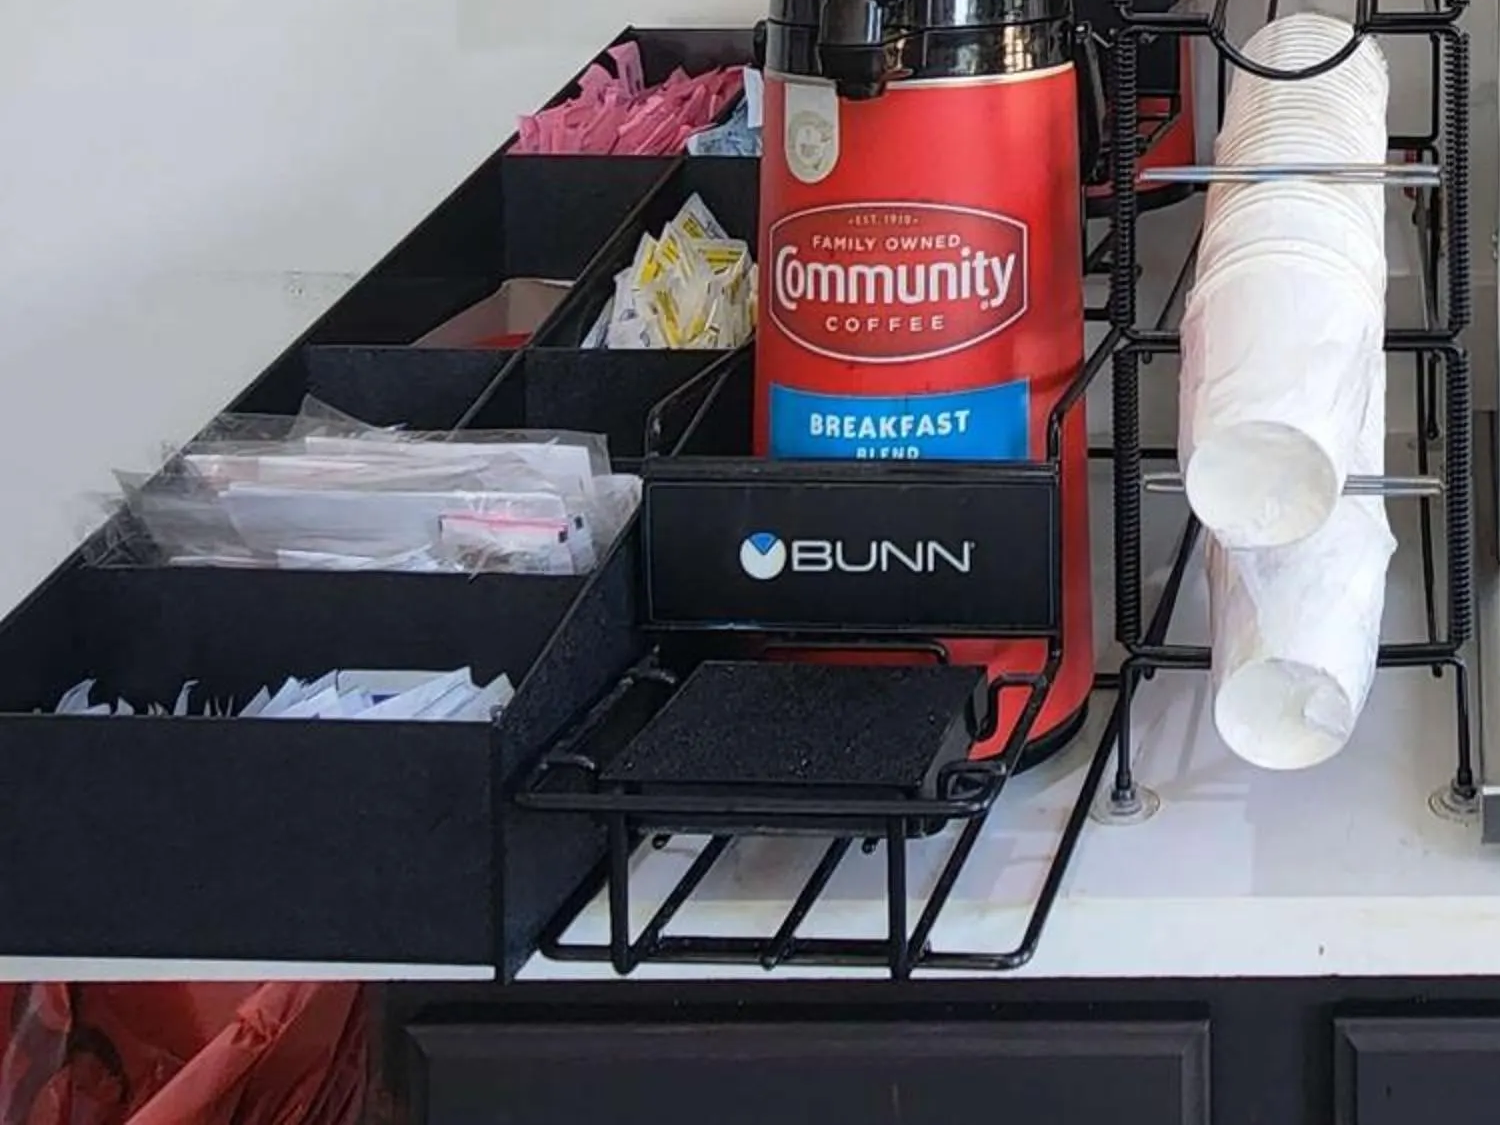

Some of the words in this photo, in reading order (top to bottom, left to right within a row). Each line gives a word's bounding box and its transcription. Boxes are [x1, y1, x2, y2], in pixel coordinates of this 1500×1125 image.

[813, 235, 876, 251] FAMILY
[886, 233, 961, 251] OWNED
[775, 244, 1016, 311] Community
[825, 315, 945, 332] COFFEE
[810, 410, 970, 439] BREAKFAST
[791, 540, 971, 573] BUNN
